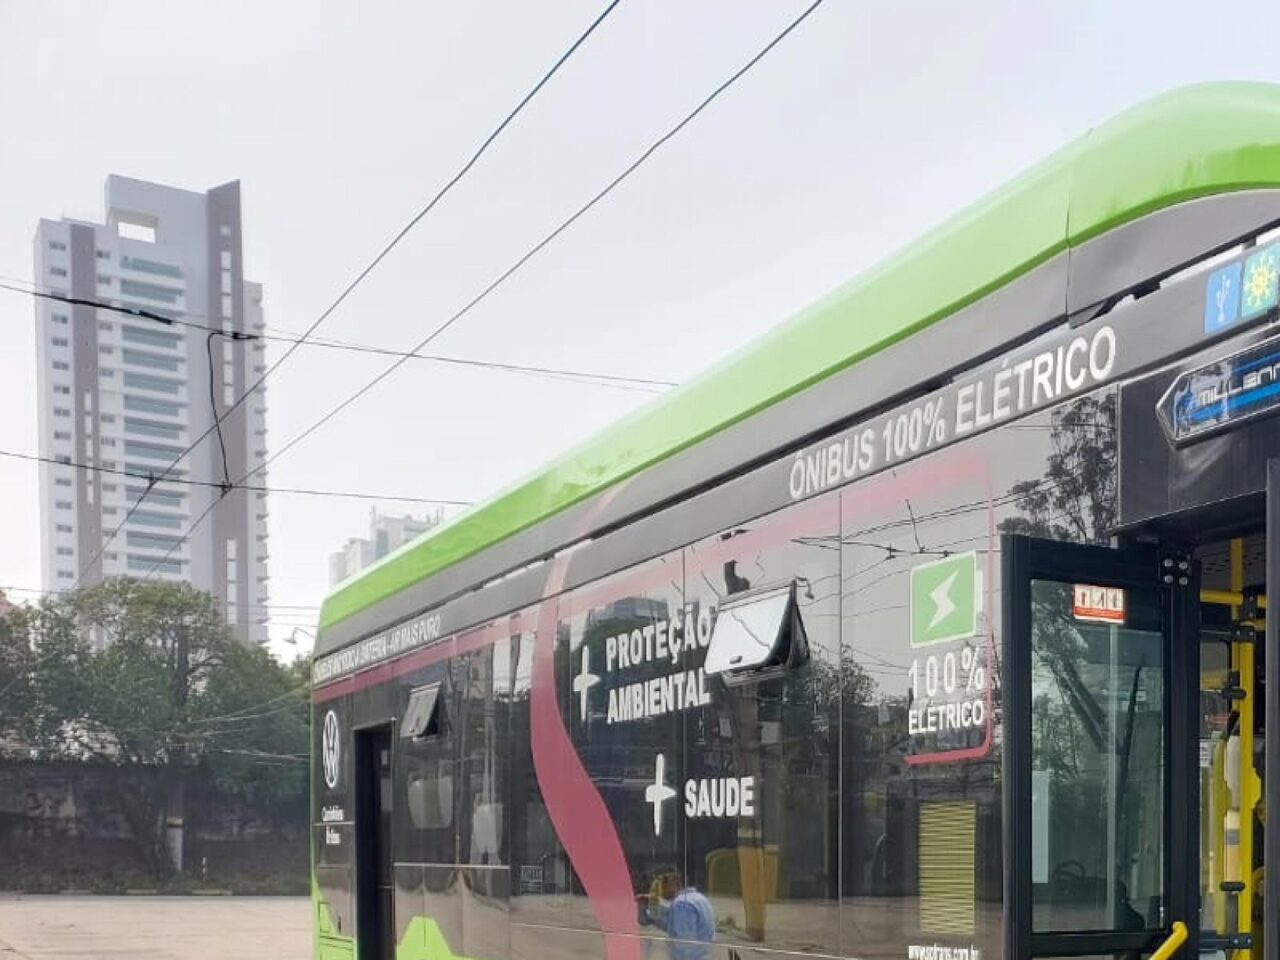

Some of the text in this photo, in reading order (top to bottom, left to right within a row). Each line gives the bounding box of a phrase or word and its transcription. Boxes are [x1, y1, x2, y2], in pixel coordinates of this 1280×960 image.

[788, 325, 1117, 500] ÔNIBUS 100% ELÉTRICO
[605, 602, 712, 672] PROTEÇÃO
[607, 670, 711, 723] AMBIENTAL
[908, 648, 985, 699] 100%
[908, 698, 985, 736] ELÉTRICO
[684, 776, 755, 818] SAUDE
